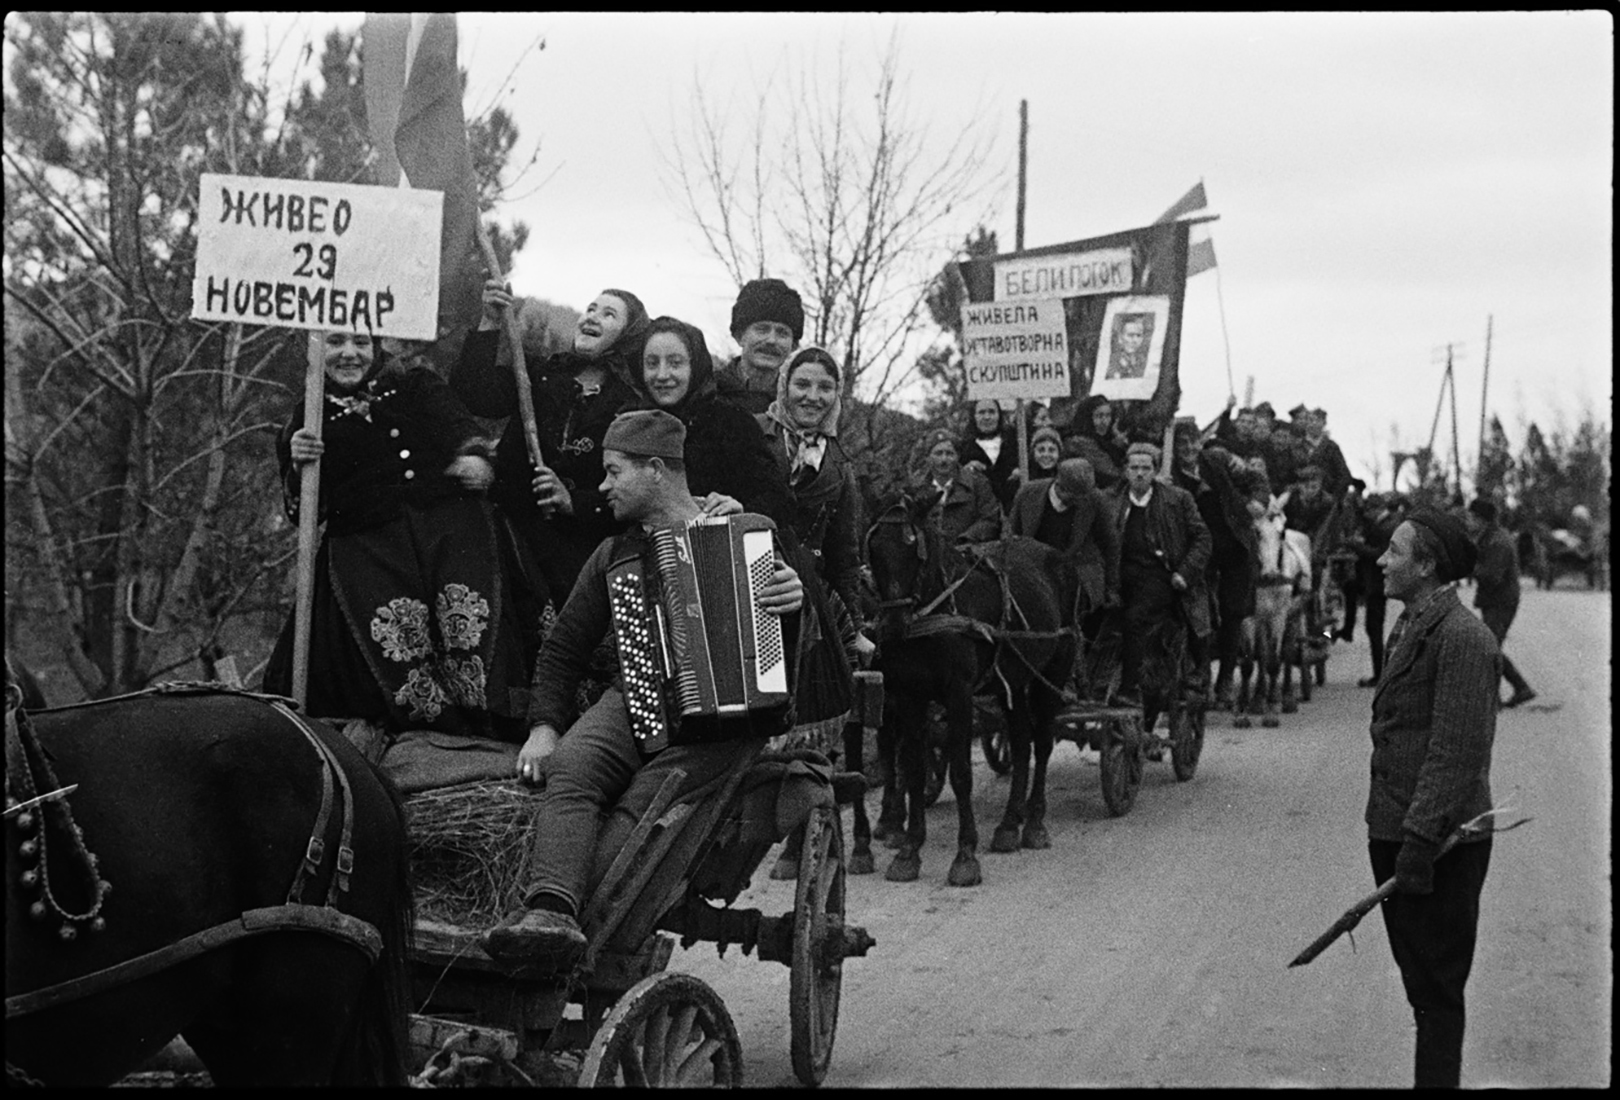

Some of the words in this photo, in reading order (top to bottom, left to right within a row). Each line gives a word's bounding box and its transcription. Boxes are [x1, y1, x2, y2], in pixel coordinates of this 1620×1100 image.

[220, 187, 352, 236] ЖИВЕО
[292, 242, 337, 280] 29
[206, 275, 395, 331] НОВЕМБАР
[966, 306, 1038, 326] ЖИВЕЛА
[970, 362, 1065, 383] СКУПШТИНА
